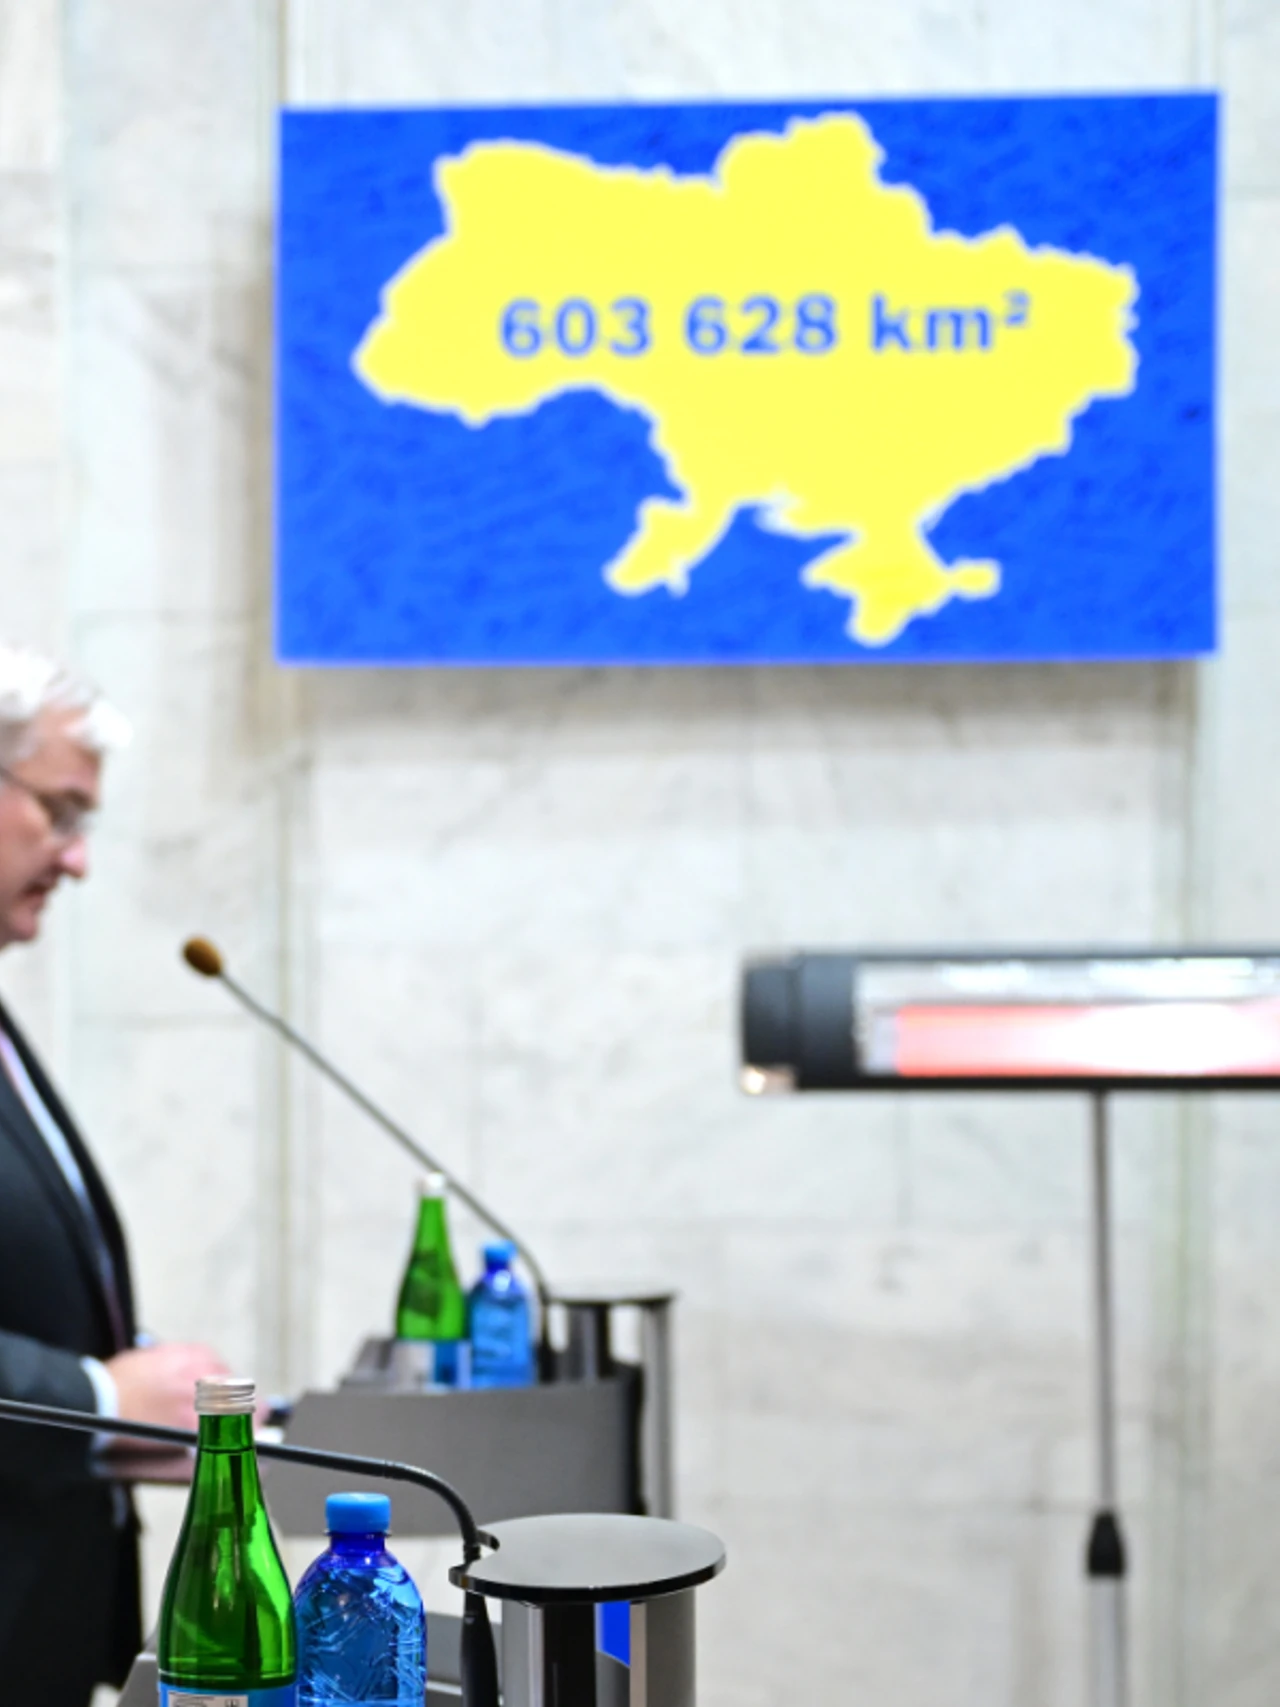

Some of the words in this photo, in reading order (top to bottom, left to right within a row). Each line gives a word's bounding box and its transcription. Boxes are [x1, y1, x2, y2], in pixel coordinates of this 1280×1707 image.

[499, 297, 653, 358] 603
[684, 294, 838, 356] 628
[871, 290, 1030, 353] km²
